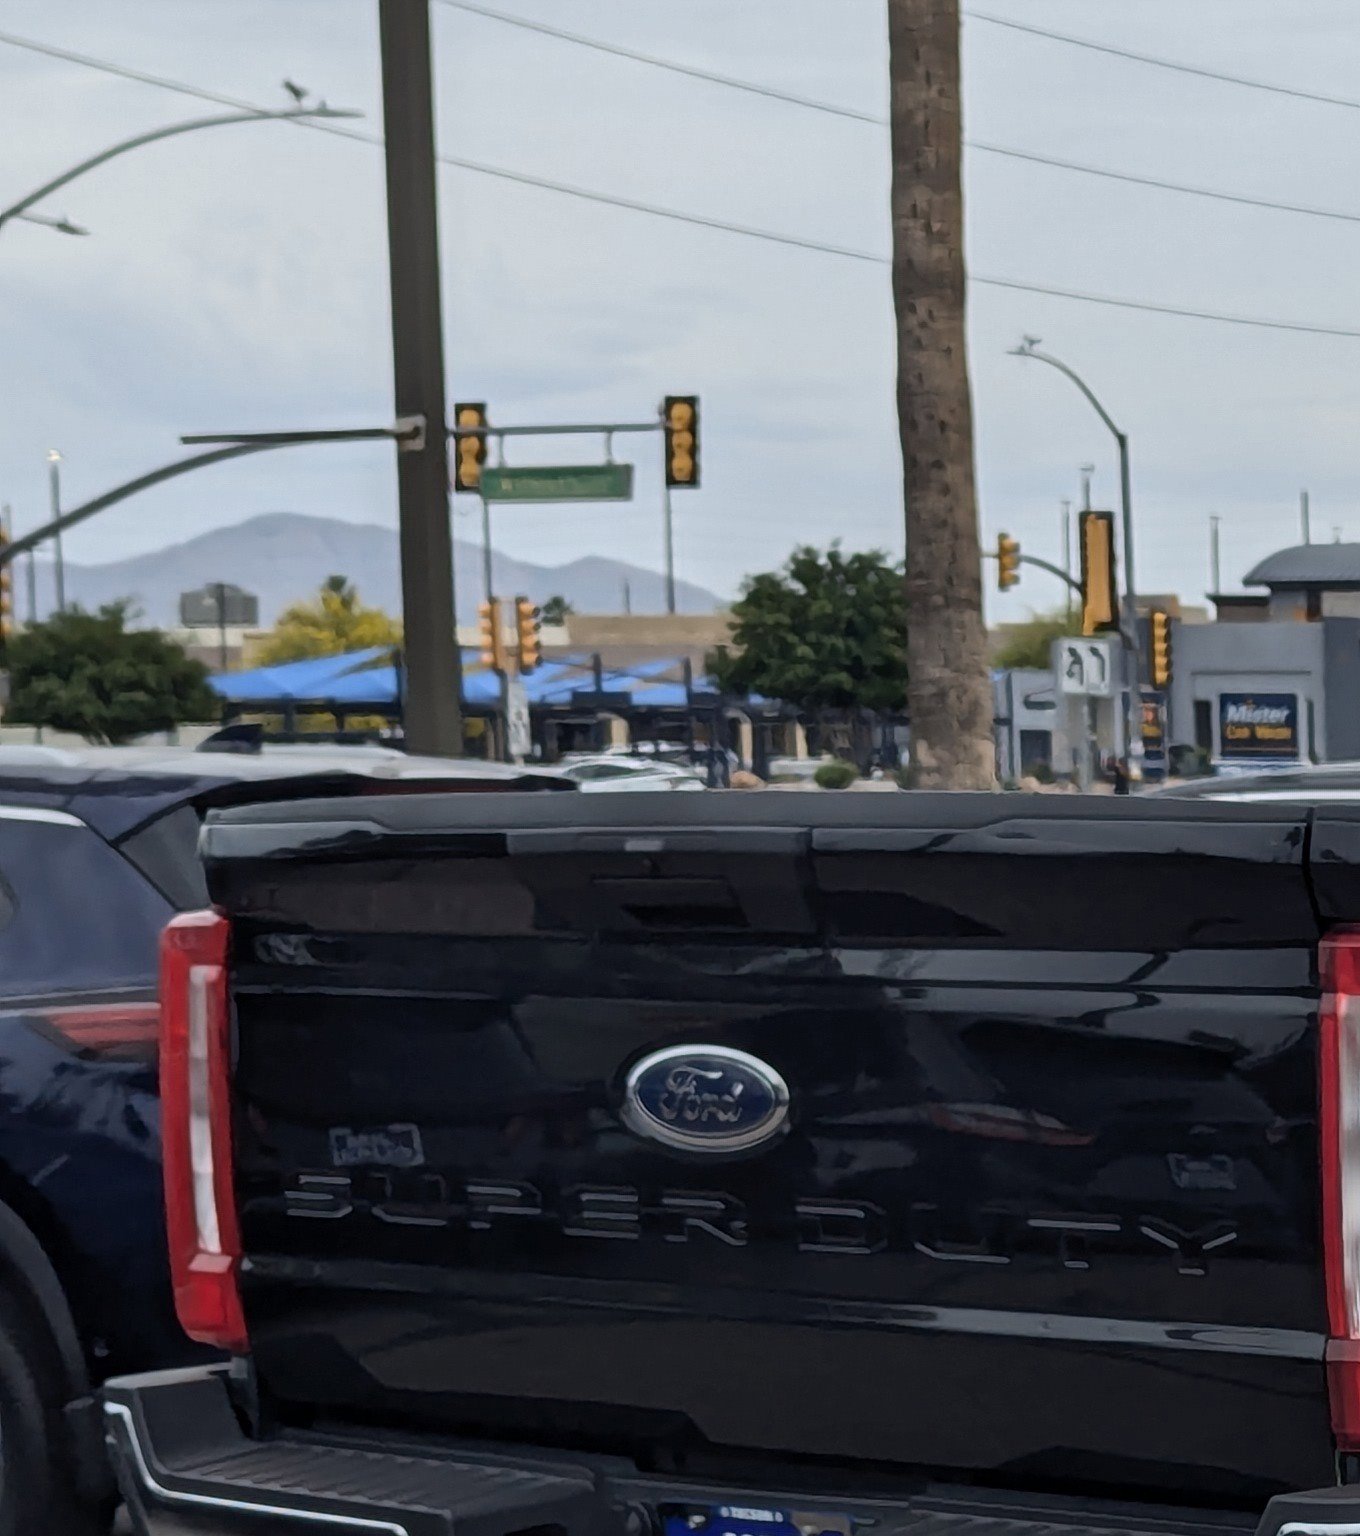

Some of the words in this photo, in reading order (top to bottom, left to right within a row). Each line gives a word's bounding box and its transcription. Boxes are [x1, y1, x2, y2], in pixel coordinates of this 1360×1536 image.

[658, 1065, 745, 1122] Ford
[284, 1169, 749, 1247] SUPER
[794, 1198, 1238, 1276] DUTY
